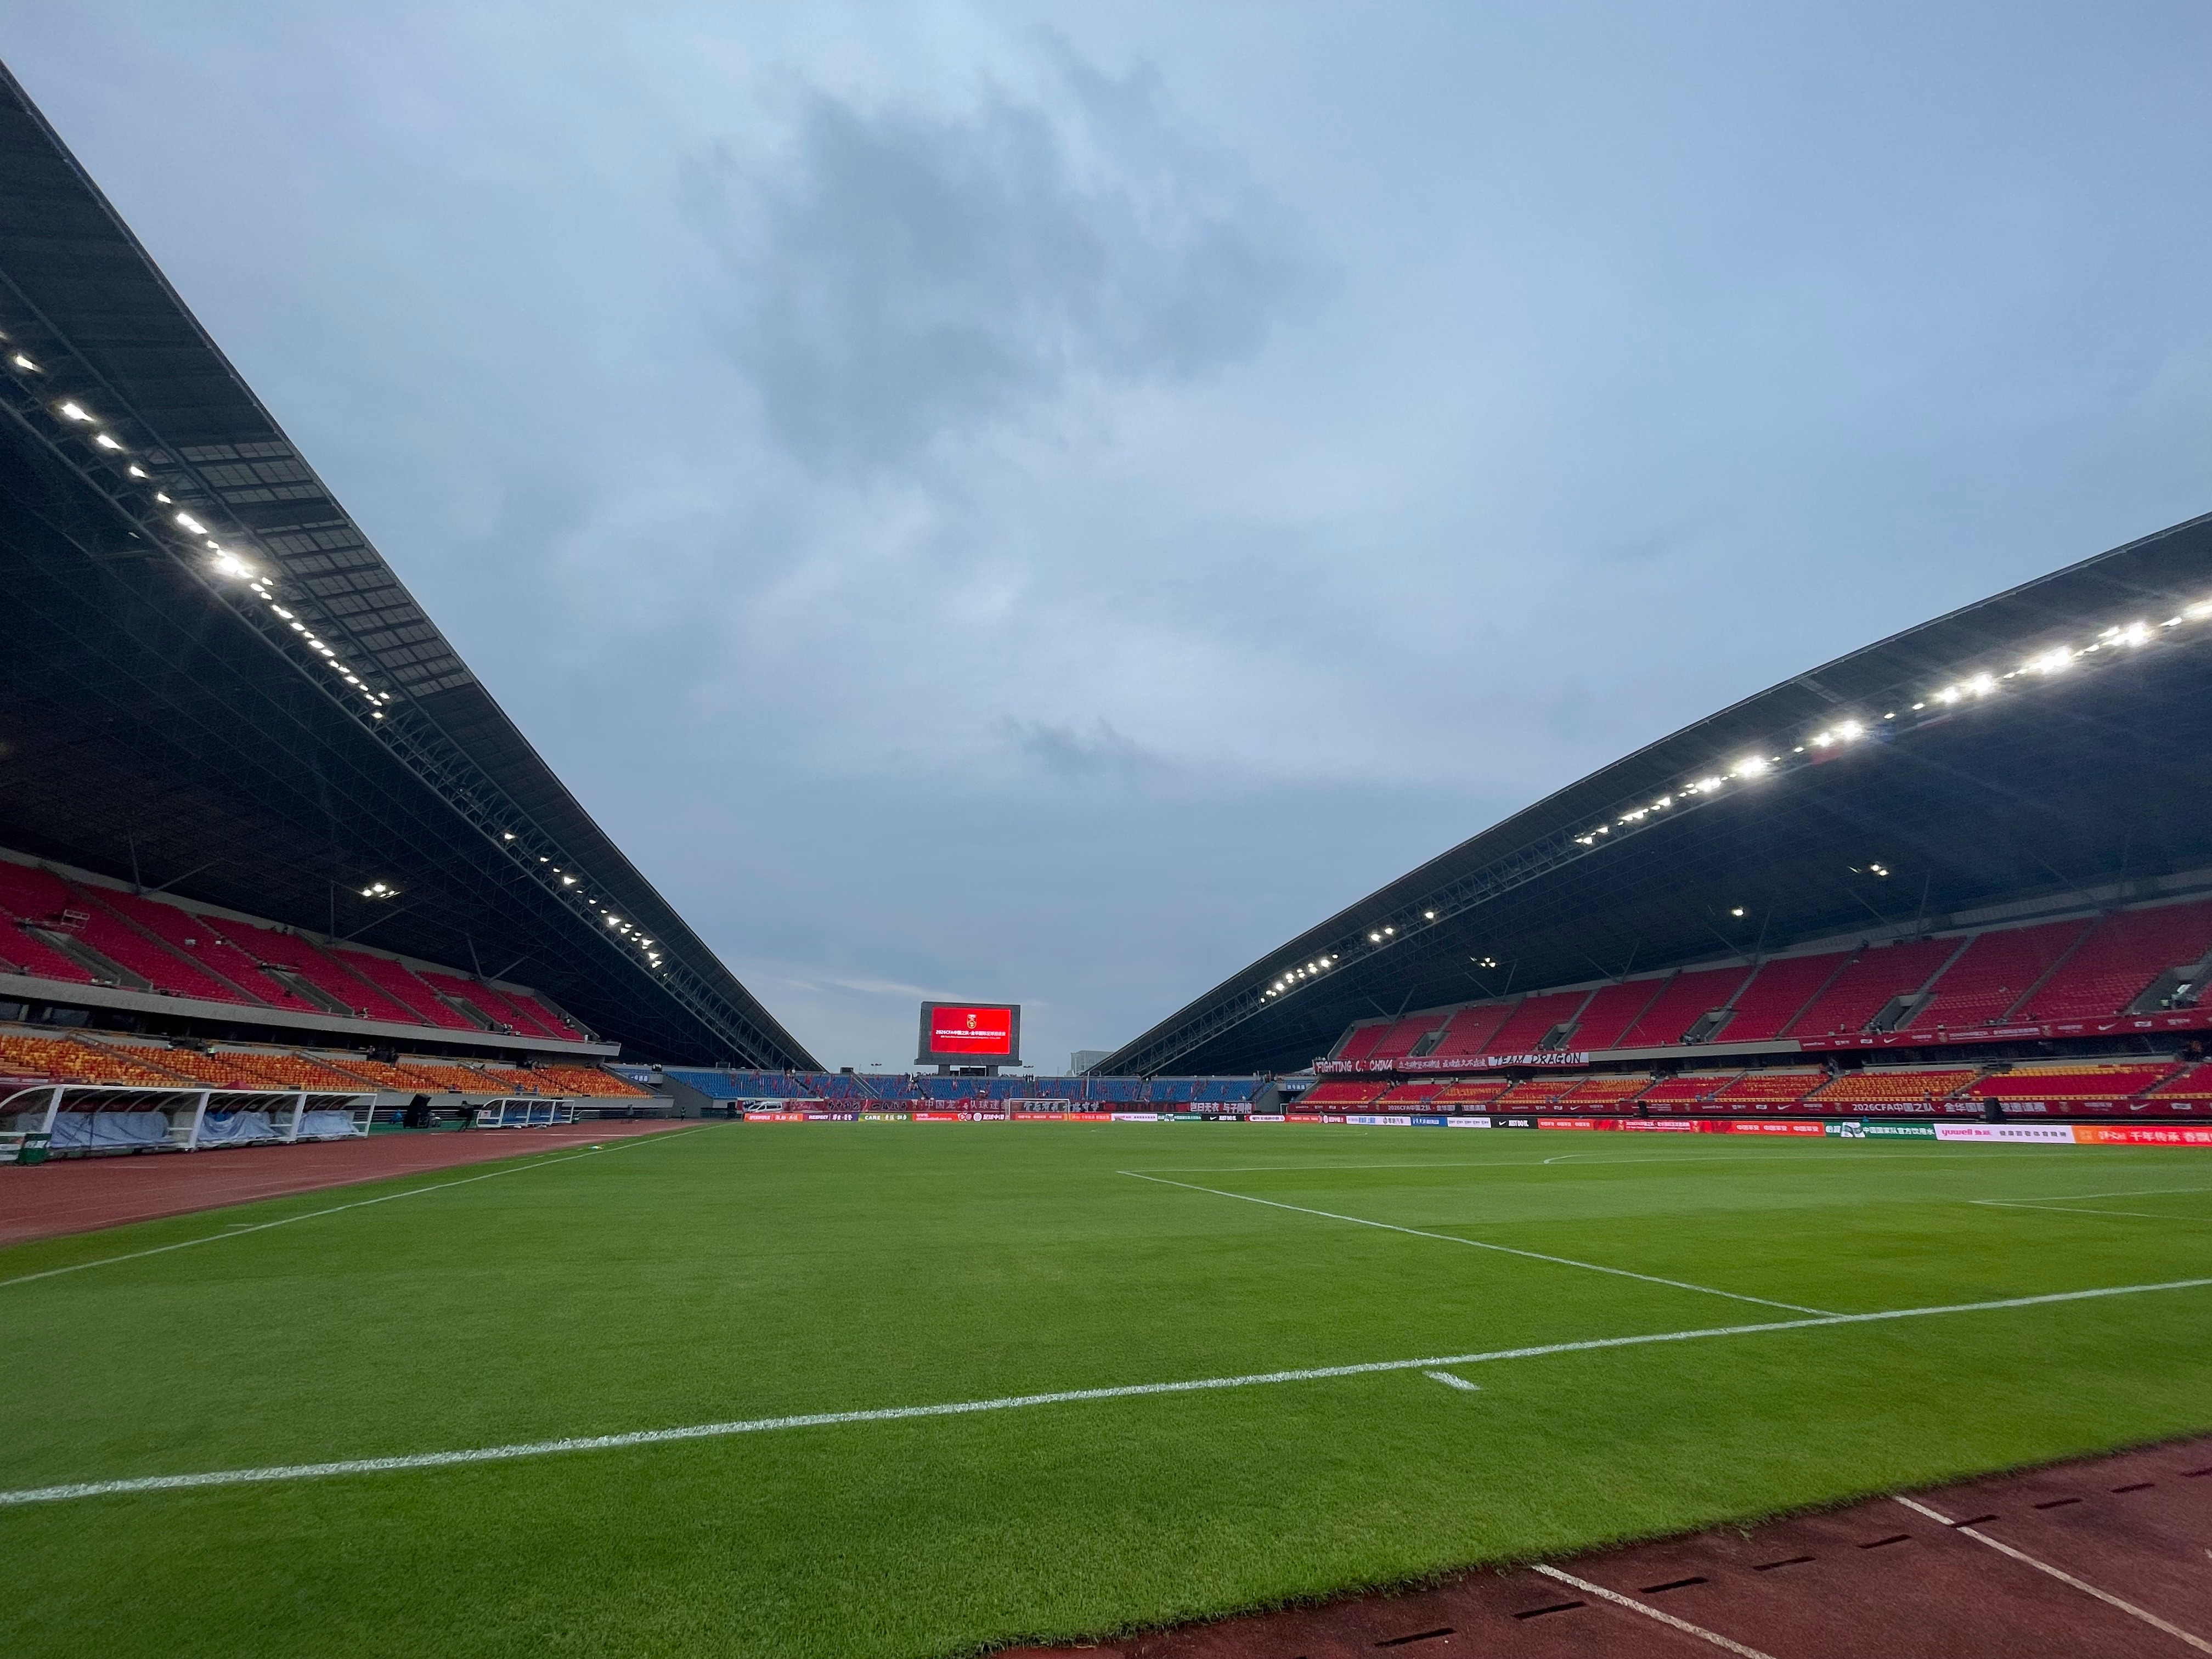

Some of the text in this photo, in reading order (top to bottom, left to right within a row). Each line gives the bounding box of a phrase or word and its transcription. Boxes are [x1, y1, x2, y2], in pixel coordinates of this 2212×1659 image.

[1494, 1052, 1581, 1064] TEAM DRAGON
[1317, 1061, 1352, 1073] FIGHTING
[1370, 1059, 1393, 1071] CHINA
